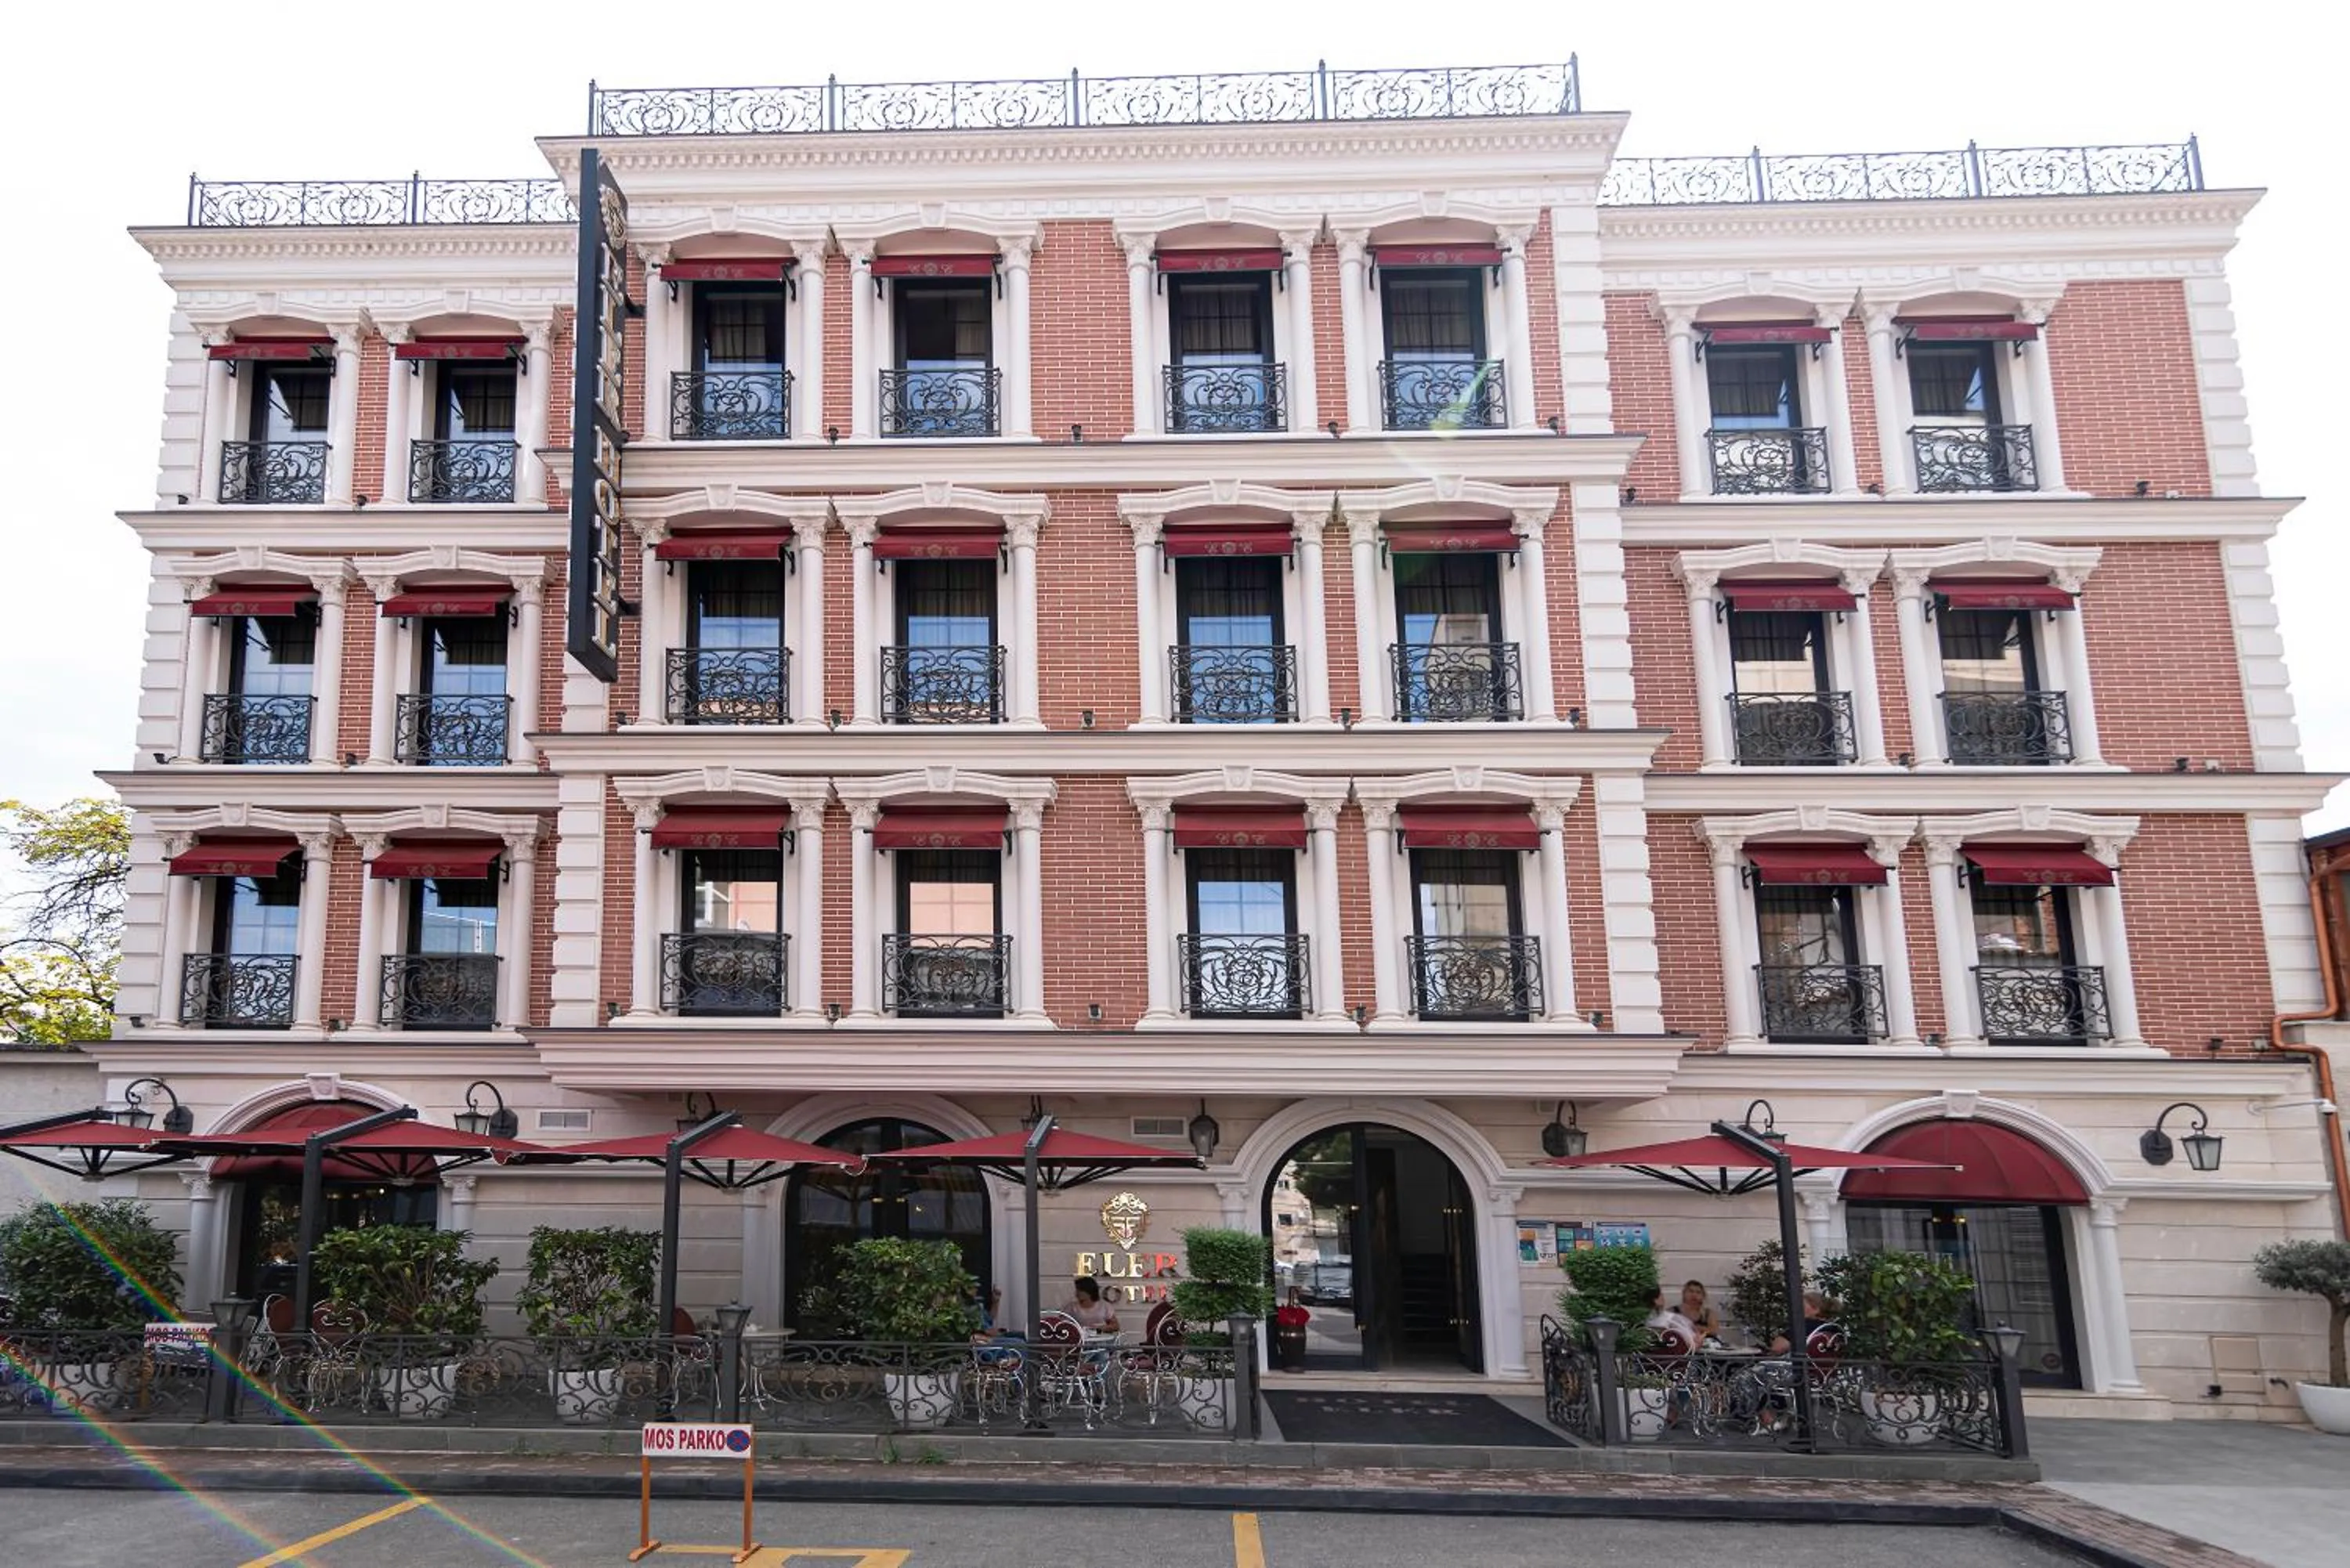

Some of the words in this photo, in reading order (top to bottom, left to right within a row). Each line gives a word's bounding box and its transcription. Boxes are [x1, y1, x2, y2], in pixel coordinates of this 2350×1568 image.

[591, 425, 621, 659] HOTEL
[1076, 1252, 1180, 1278] ELER
[643, 1428, 675, 1450] MOS
[679, 1429, 725, 1450] PARKO
